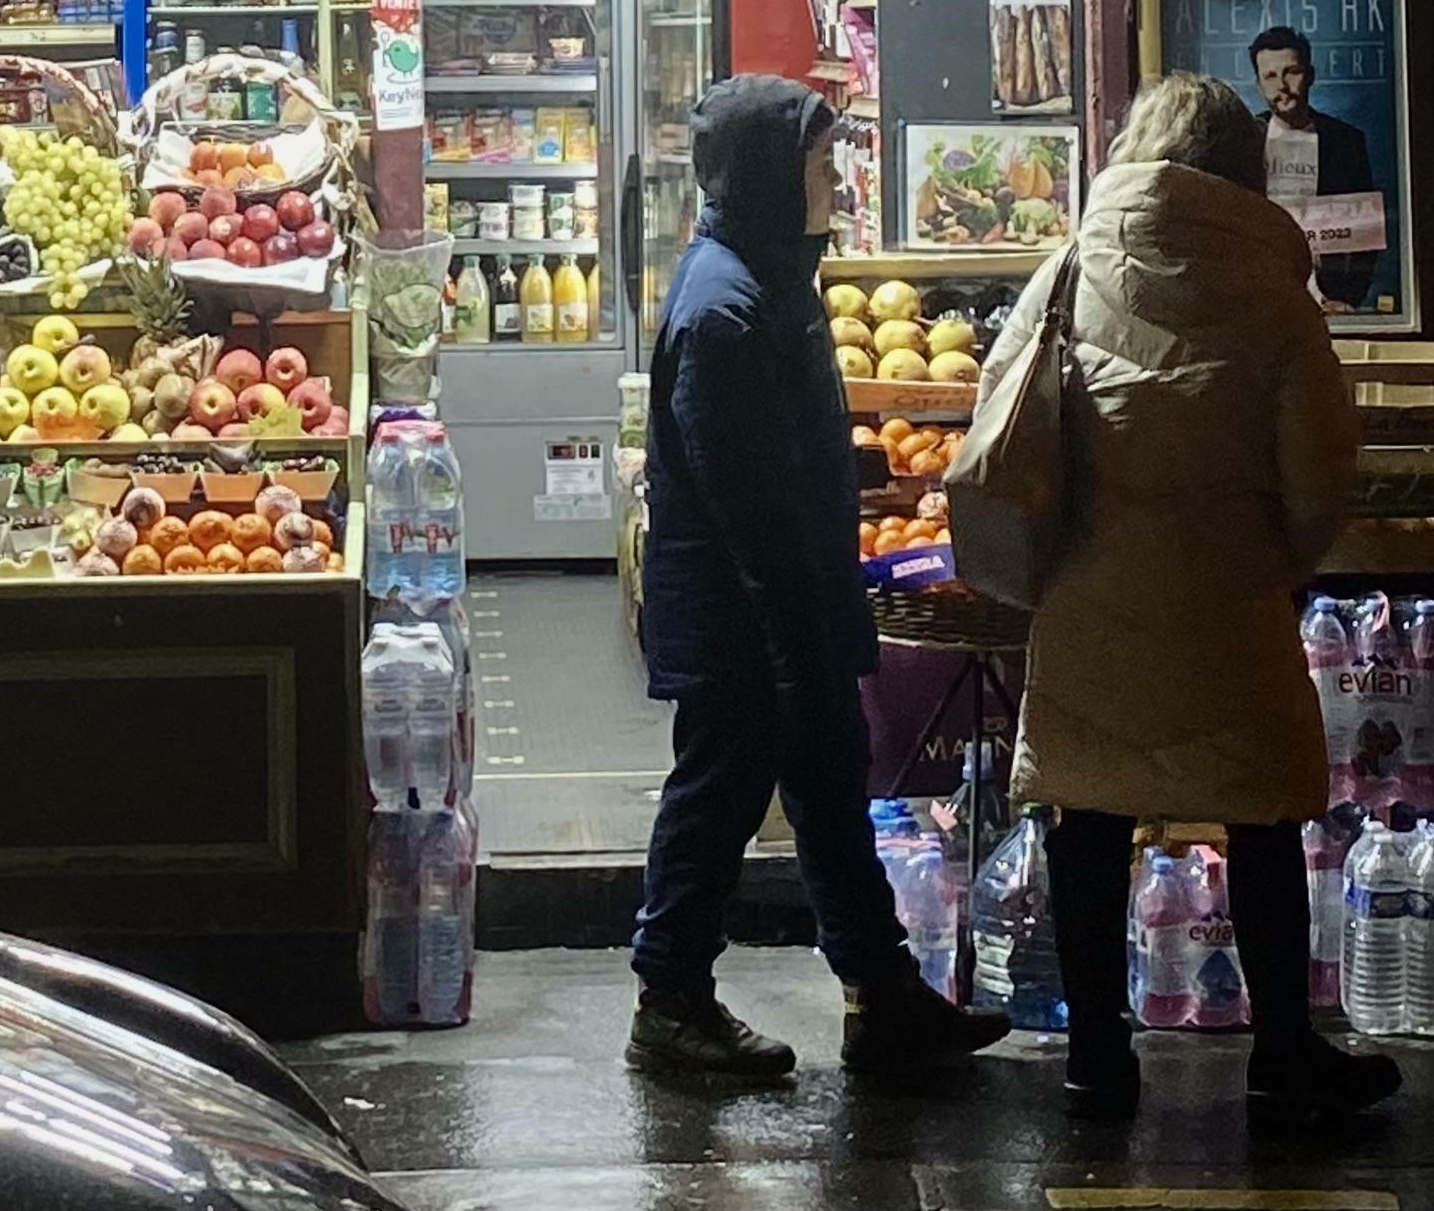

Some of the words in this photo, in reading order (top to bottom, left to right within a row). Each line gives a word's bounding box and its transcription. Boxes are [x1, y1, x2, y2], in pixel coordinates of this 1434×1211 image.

[1233, 47, 1387, 79] CERT
[1338, 672, 1412, 695] evian
[1188, 924, 1234, 941] evia
